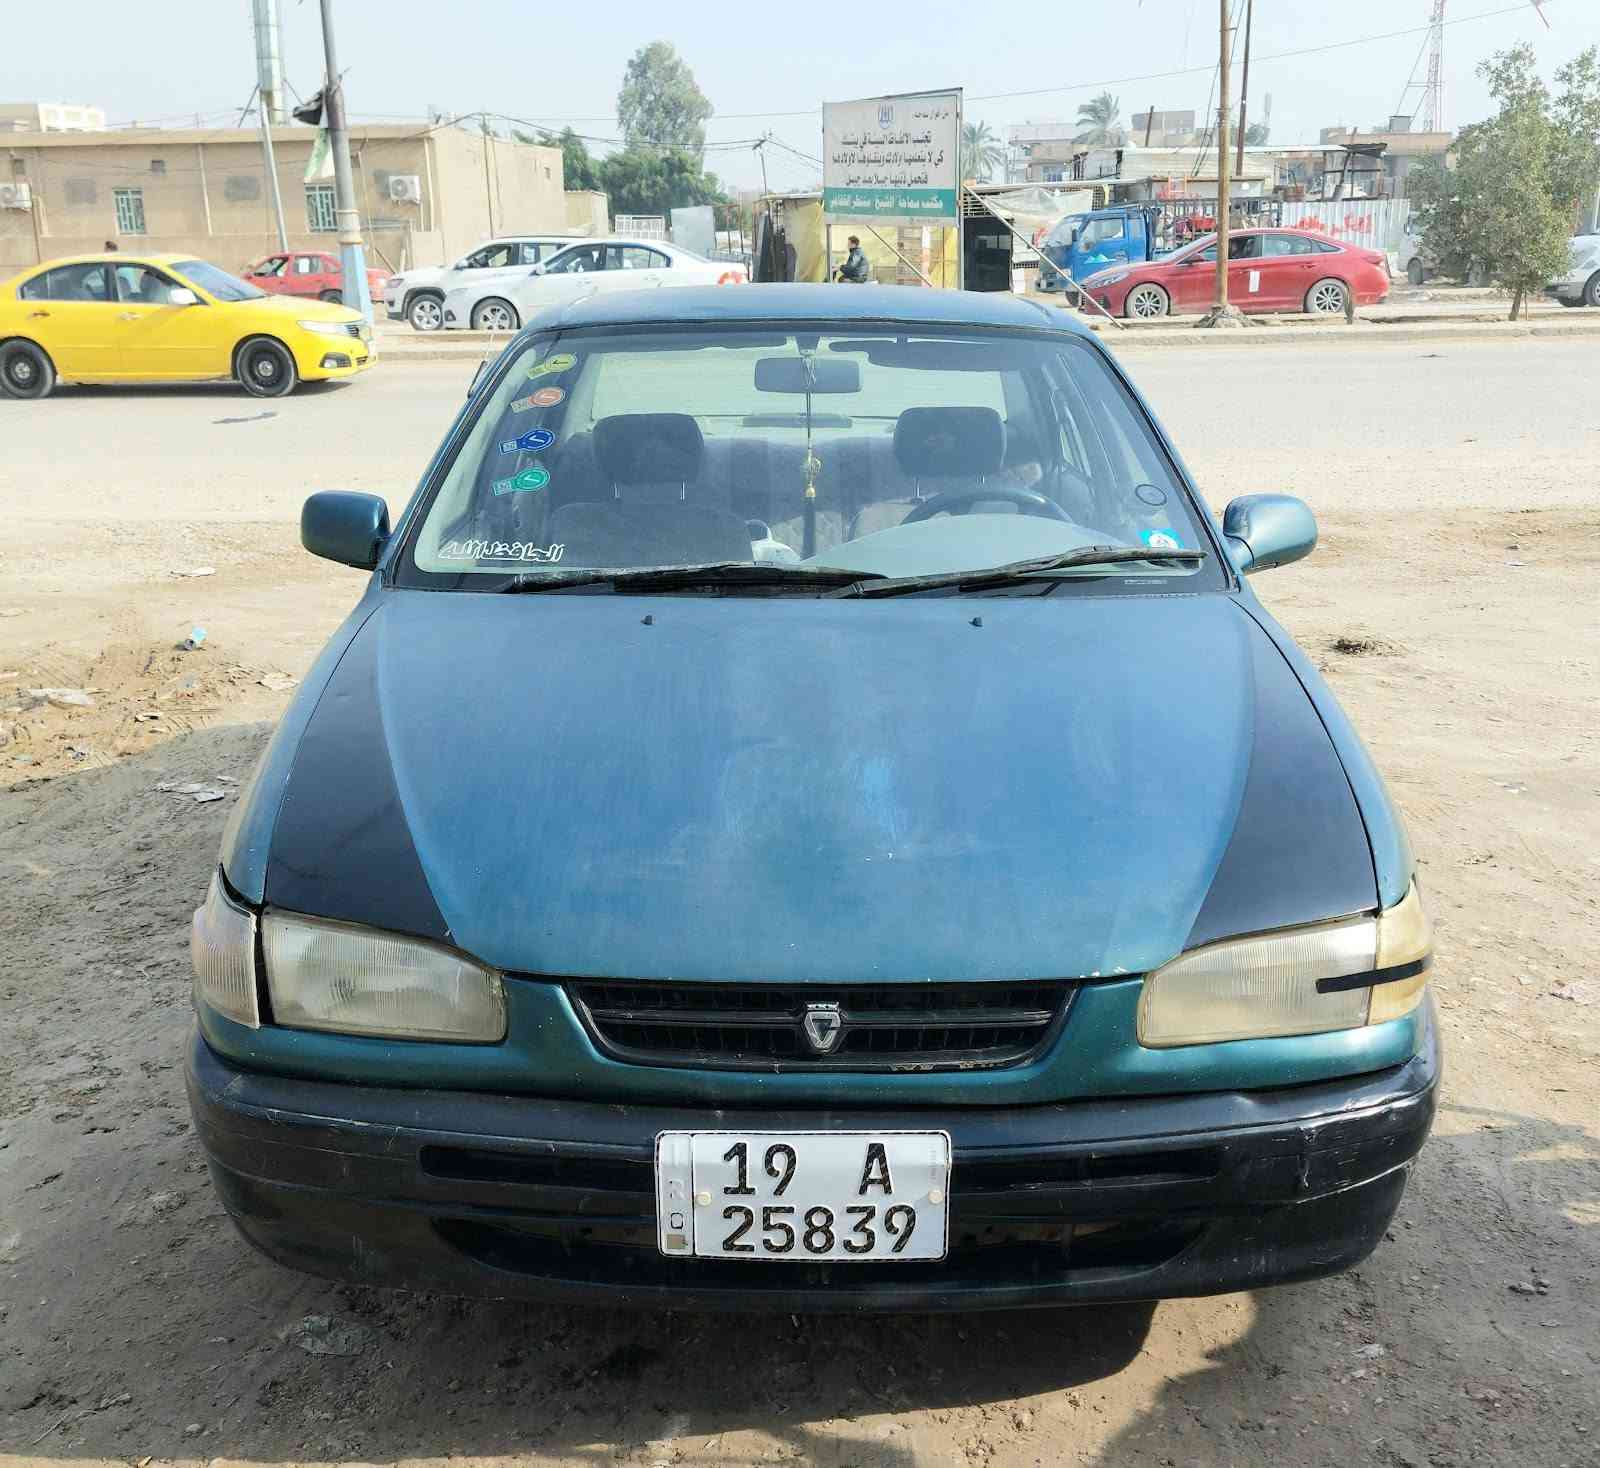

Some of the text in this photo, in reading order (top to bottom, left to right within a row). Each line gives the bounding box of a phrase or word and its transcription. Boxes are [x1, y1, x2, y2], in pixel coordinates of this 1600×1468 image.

[723, 1142, 893, 1196] 19 A
[722, 1204, 917, 1254] 25839
